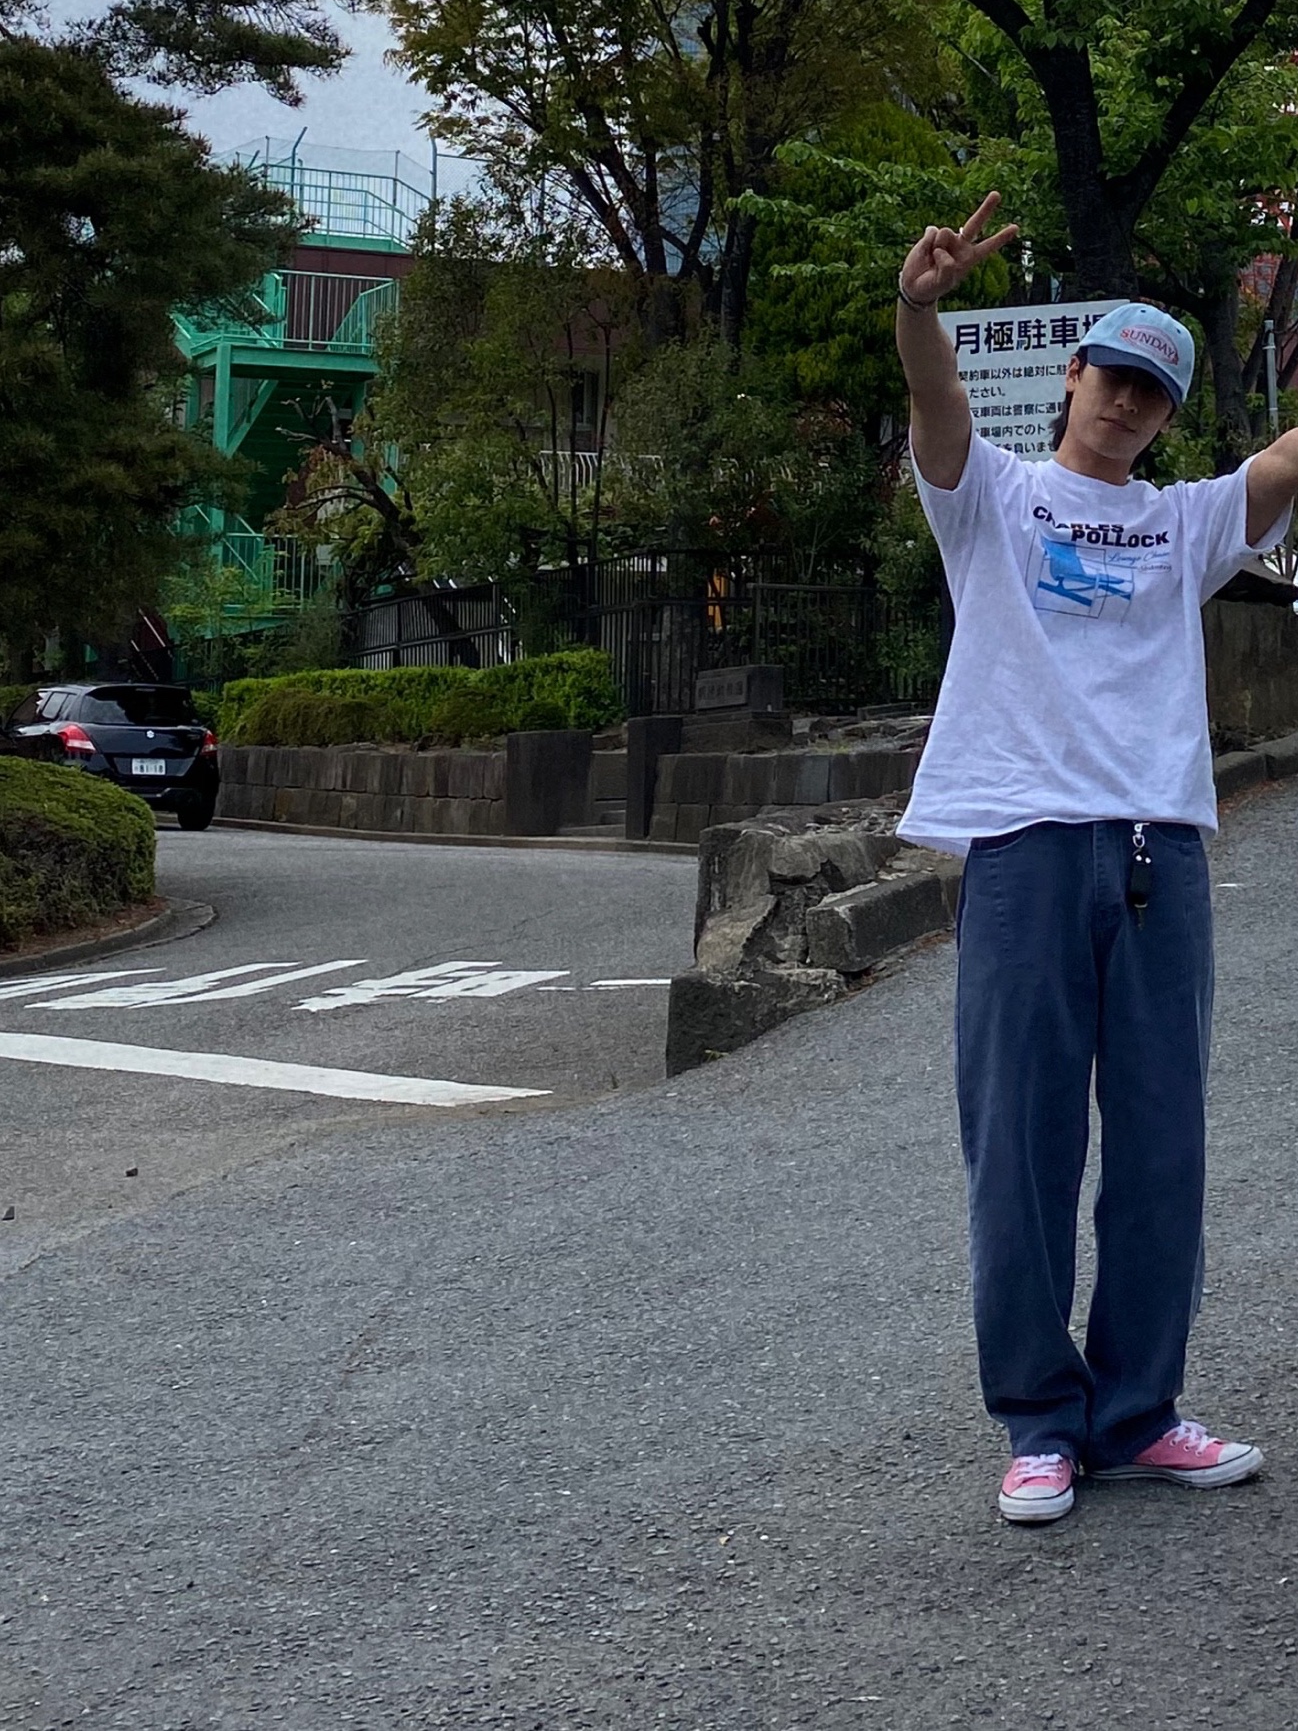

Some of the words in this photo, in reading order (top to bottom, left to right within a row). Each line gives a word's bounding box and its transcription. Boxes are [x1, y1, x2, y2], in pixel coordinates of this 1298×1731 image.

[976, 423, 1056, 438] 車場内でのト
[1071, 530, 1170, 548] POLLOCK
